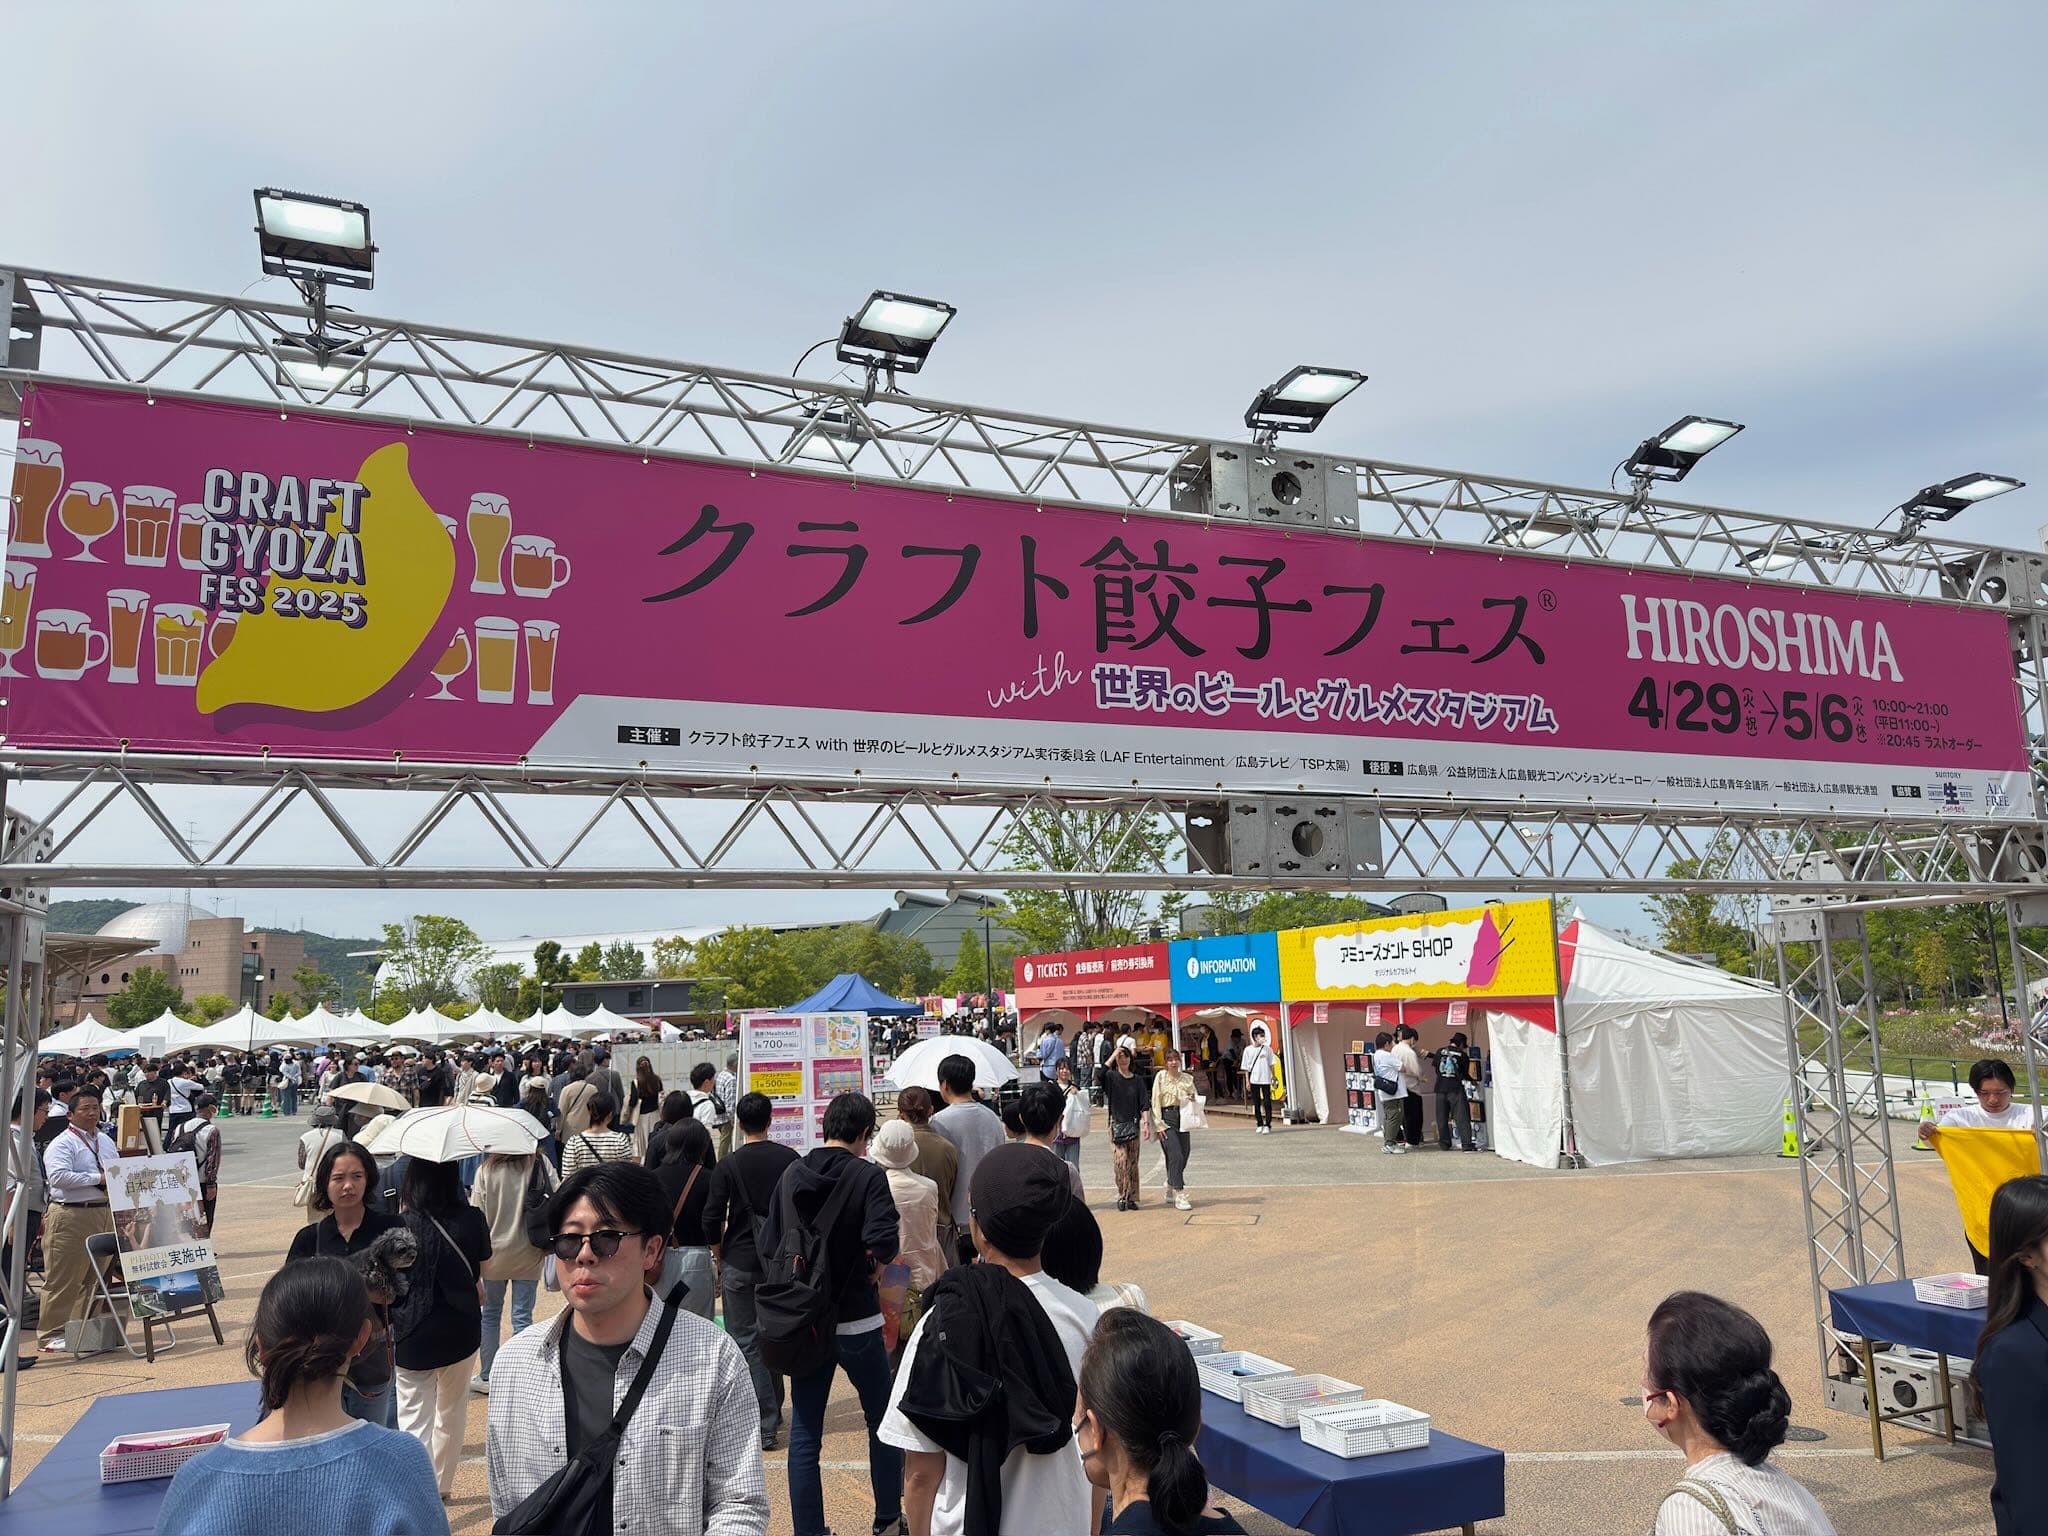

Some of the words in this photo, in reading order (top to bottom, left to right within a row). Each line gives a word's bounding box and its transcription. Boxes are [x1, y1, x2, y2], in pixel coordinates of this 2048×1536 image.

[203, 468, 369, 531] CRAFT
[200, 521, 366, 585] GYOZA
[199, 574, 265, 614] FES
[272, 587, 367, 628] 2025
[1621, 595, 1904, 682] HIROSHIMA
[987, 650, 1083, 709] with
[1093, 664, 1559, 733] 世界のビールとグルメスタジアム
[1628, 677, 1741, 734] 4/29
[1783, 691, 1853, 743] 5/6
[688, 730, 811, 750] クラフト餃子フェス
[815, 738, 849, 752] with
[853, 739, 1097, 762] 世界のビールとグルメスタジアム実行委員会
[1099, 750, 1130, 765] (LAF
[1924, 736, 1983, 751] ラストオーダー
[1935, 771, 1962, 779] SUNTORY
[1986, 795, 2010, 807] FREE
[1340, 942, 1409, 963] アミューズメント
[1412, 937, 1453, 958] SHOP
[1037, 963, 1068, 978] TICKETS
[1200, 957, 1256, 974] INFORMATION
[126, 1177, 180, 1194] 日本に上陸
[168, 1245, 208, 1267] 実施中
